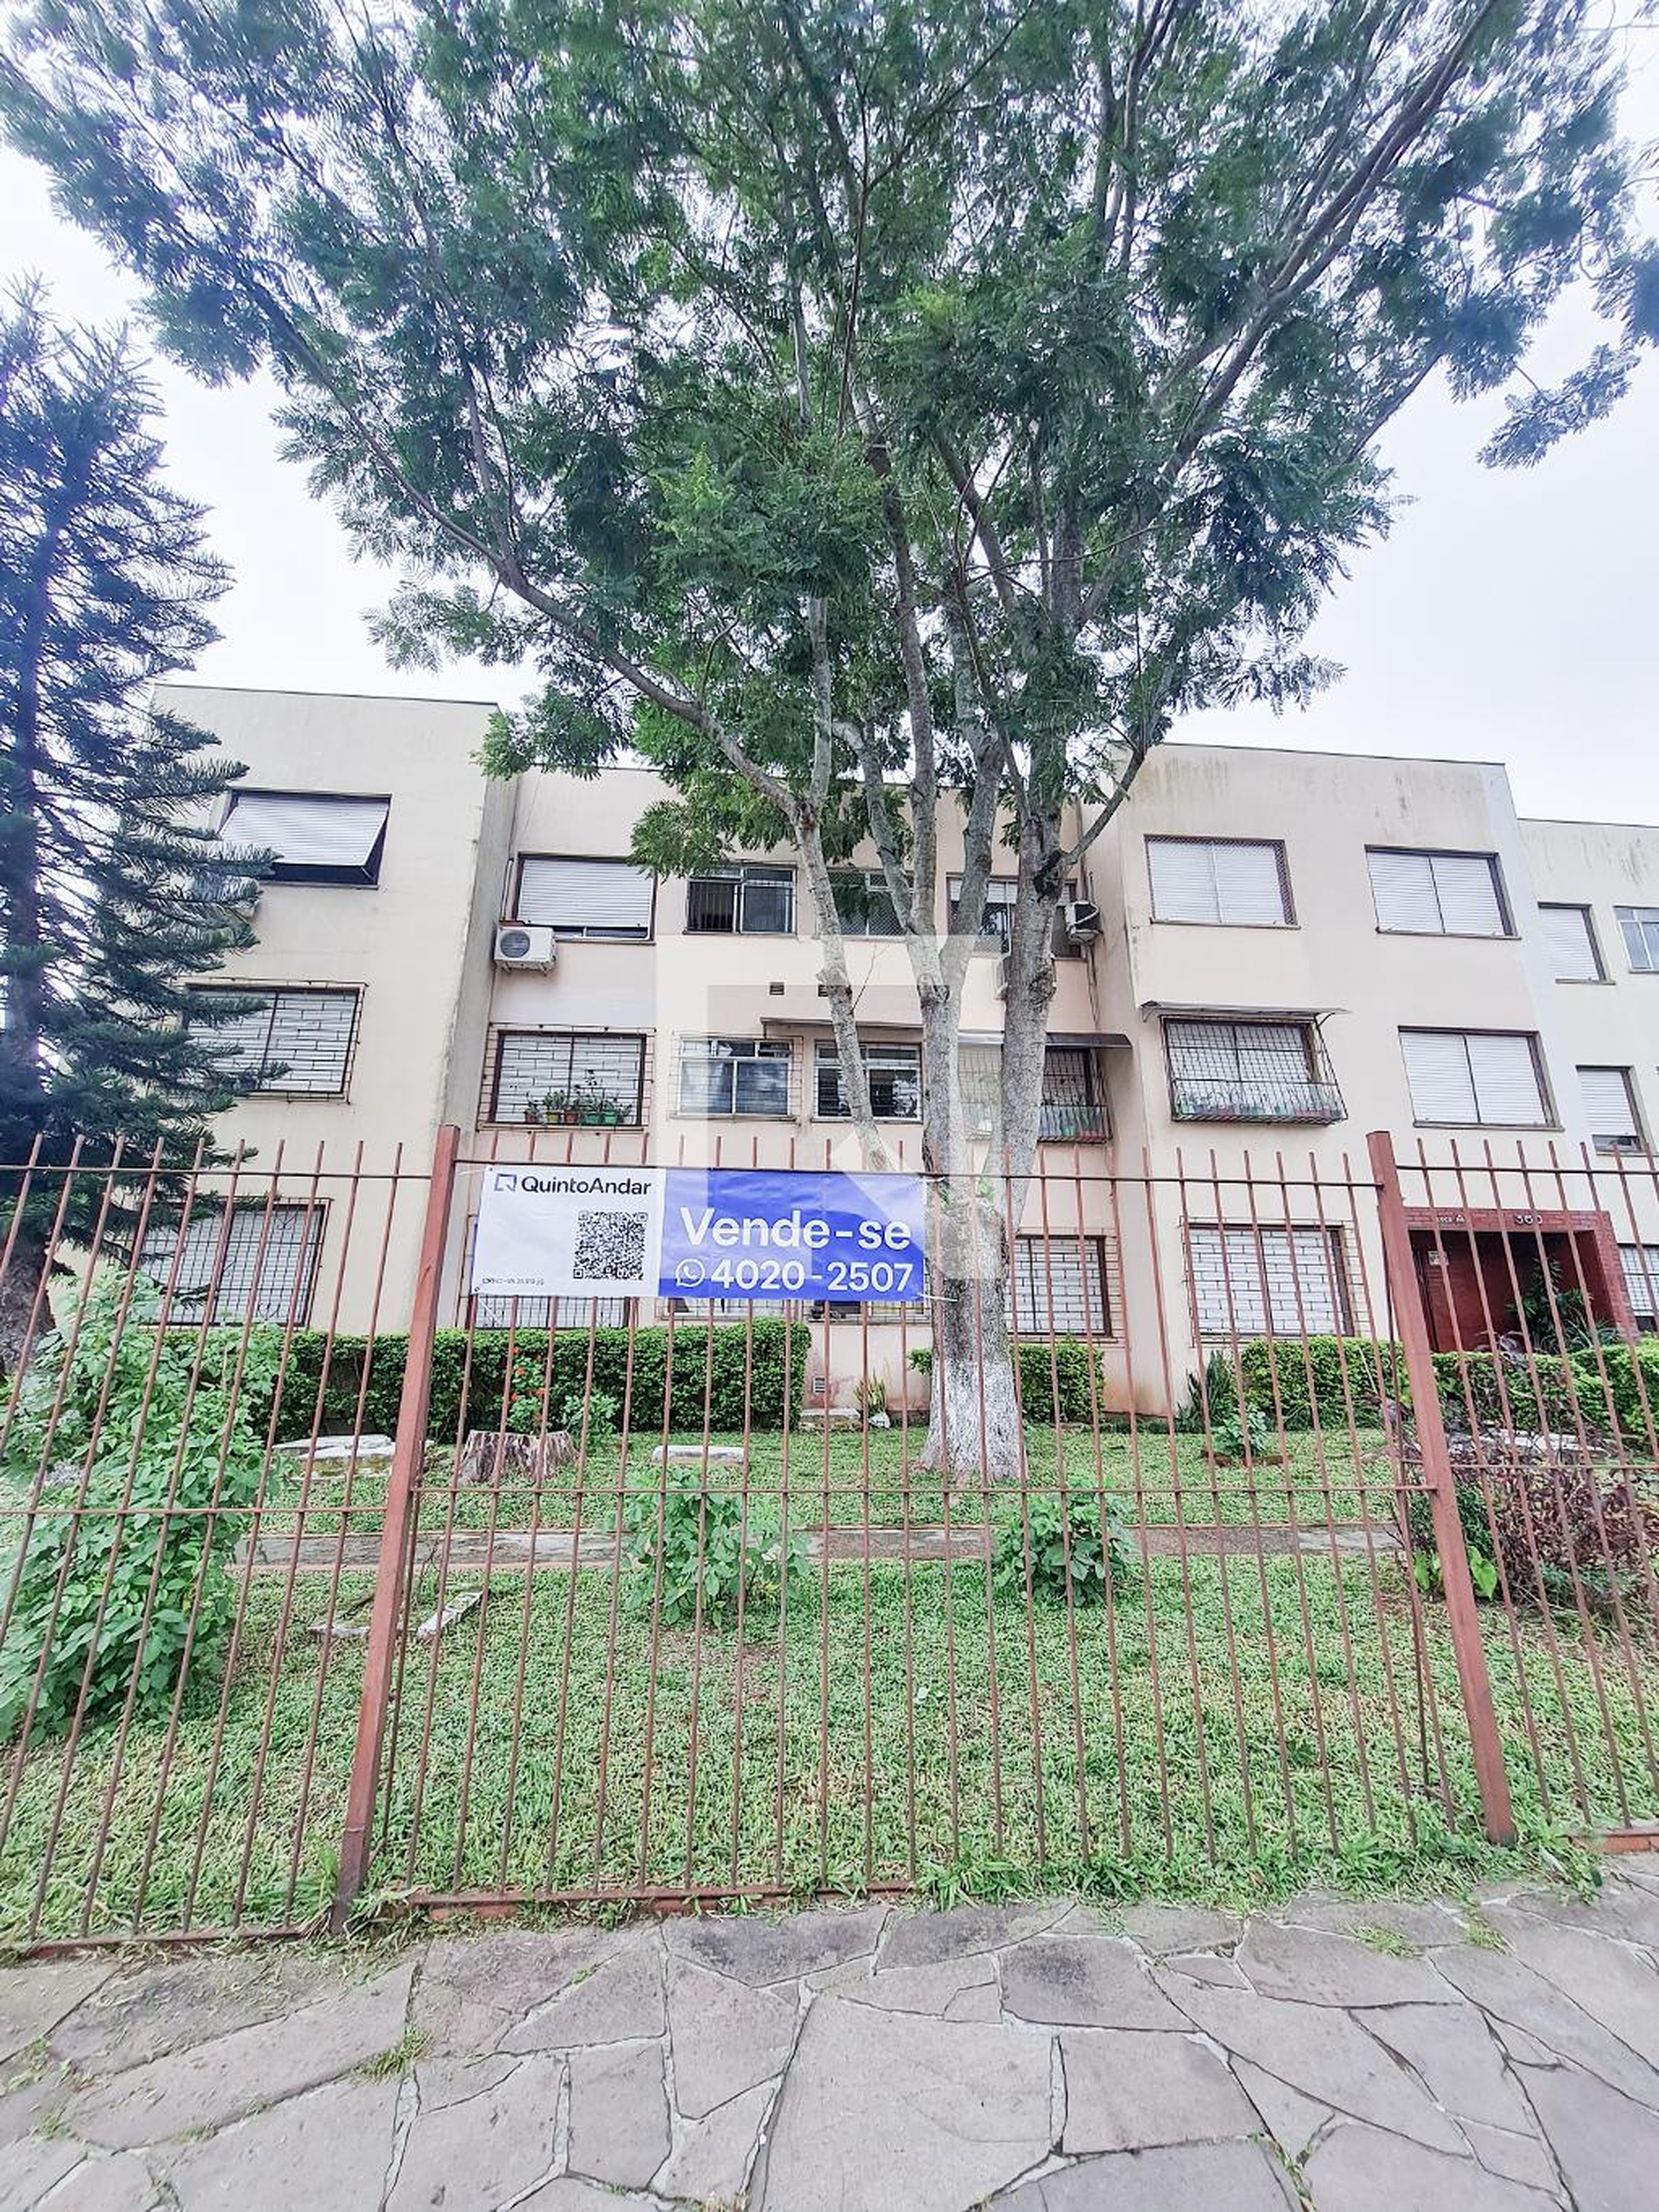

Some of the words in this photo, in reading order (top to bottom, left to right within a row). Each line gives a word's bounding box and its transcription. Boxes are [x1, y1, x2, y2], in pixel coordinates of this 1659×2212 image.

[521, 1175, 652, 1194] QuintoAndar
[680, 1207, 911, 1250] Vende-se
[711, 1260, 913, 1291] 4020-2507
